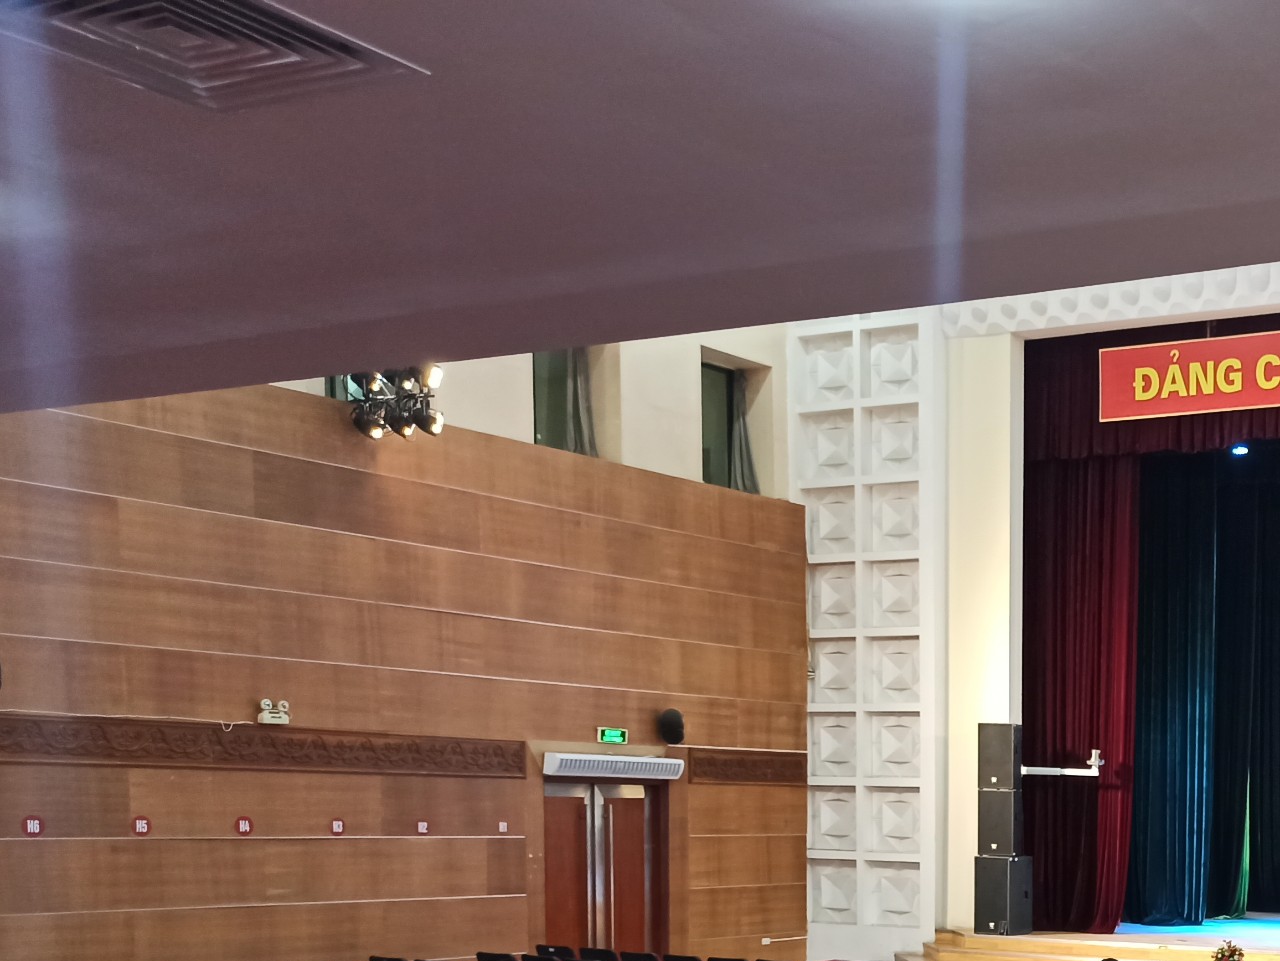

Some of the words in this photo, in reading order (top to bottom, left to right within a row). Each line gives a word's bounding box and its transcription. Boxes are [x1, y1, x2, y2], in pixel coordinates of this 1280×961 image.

[1133, 349, 1243, 400] ĐẢNG
[27, 820, 40, 833] H6
[136, 820, 148, 833] H5
[239, 820, 250, 833] H4
